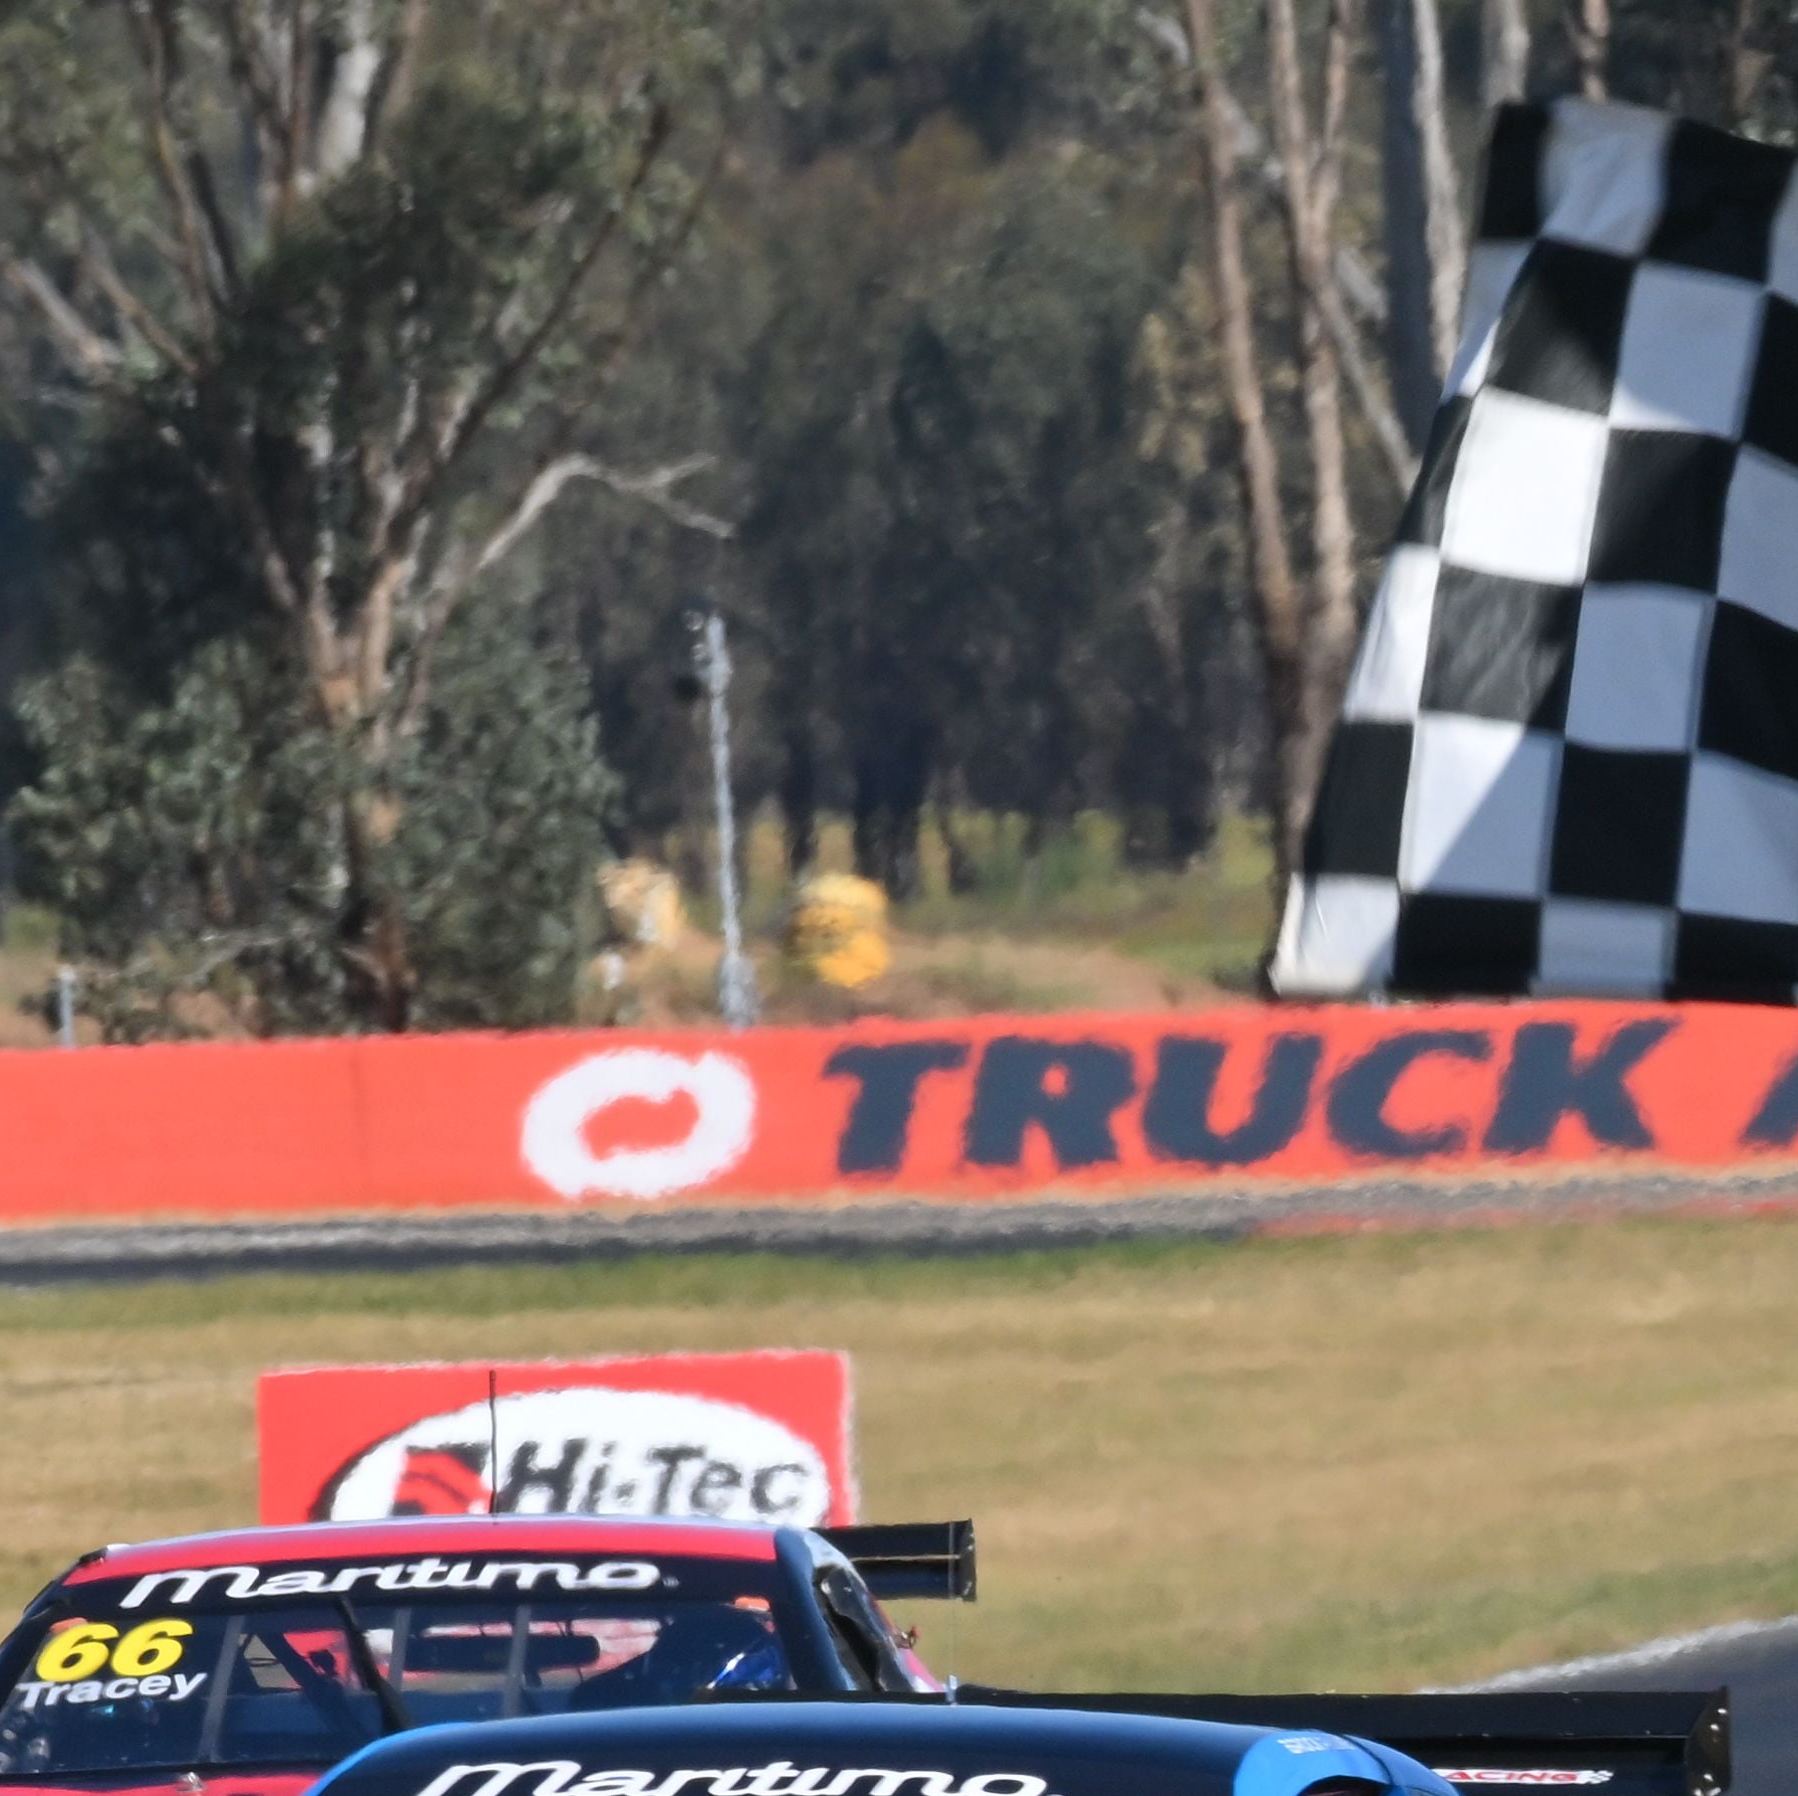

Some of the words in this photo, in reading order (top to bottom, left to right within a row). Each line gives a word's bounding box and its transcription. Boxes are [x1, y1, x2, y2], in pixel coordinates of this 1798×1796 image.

[822, 1018, 1679, 1175] TRUCK
[502, 1438, 815, 1515] Hi-Tec
[120, 1557, 661, 1610] Maritimo
[35, 1618, 194, 1683] 66
[15, 1671, 207, 1711] Tracey
[1441, 1771, 1580, 1782] ACING
